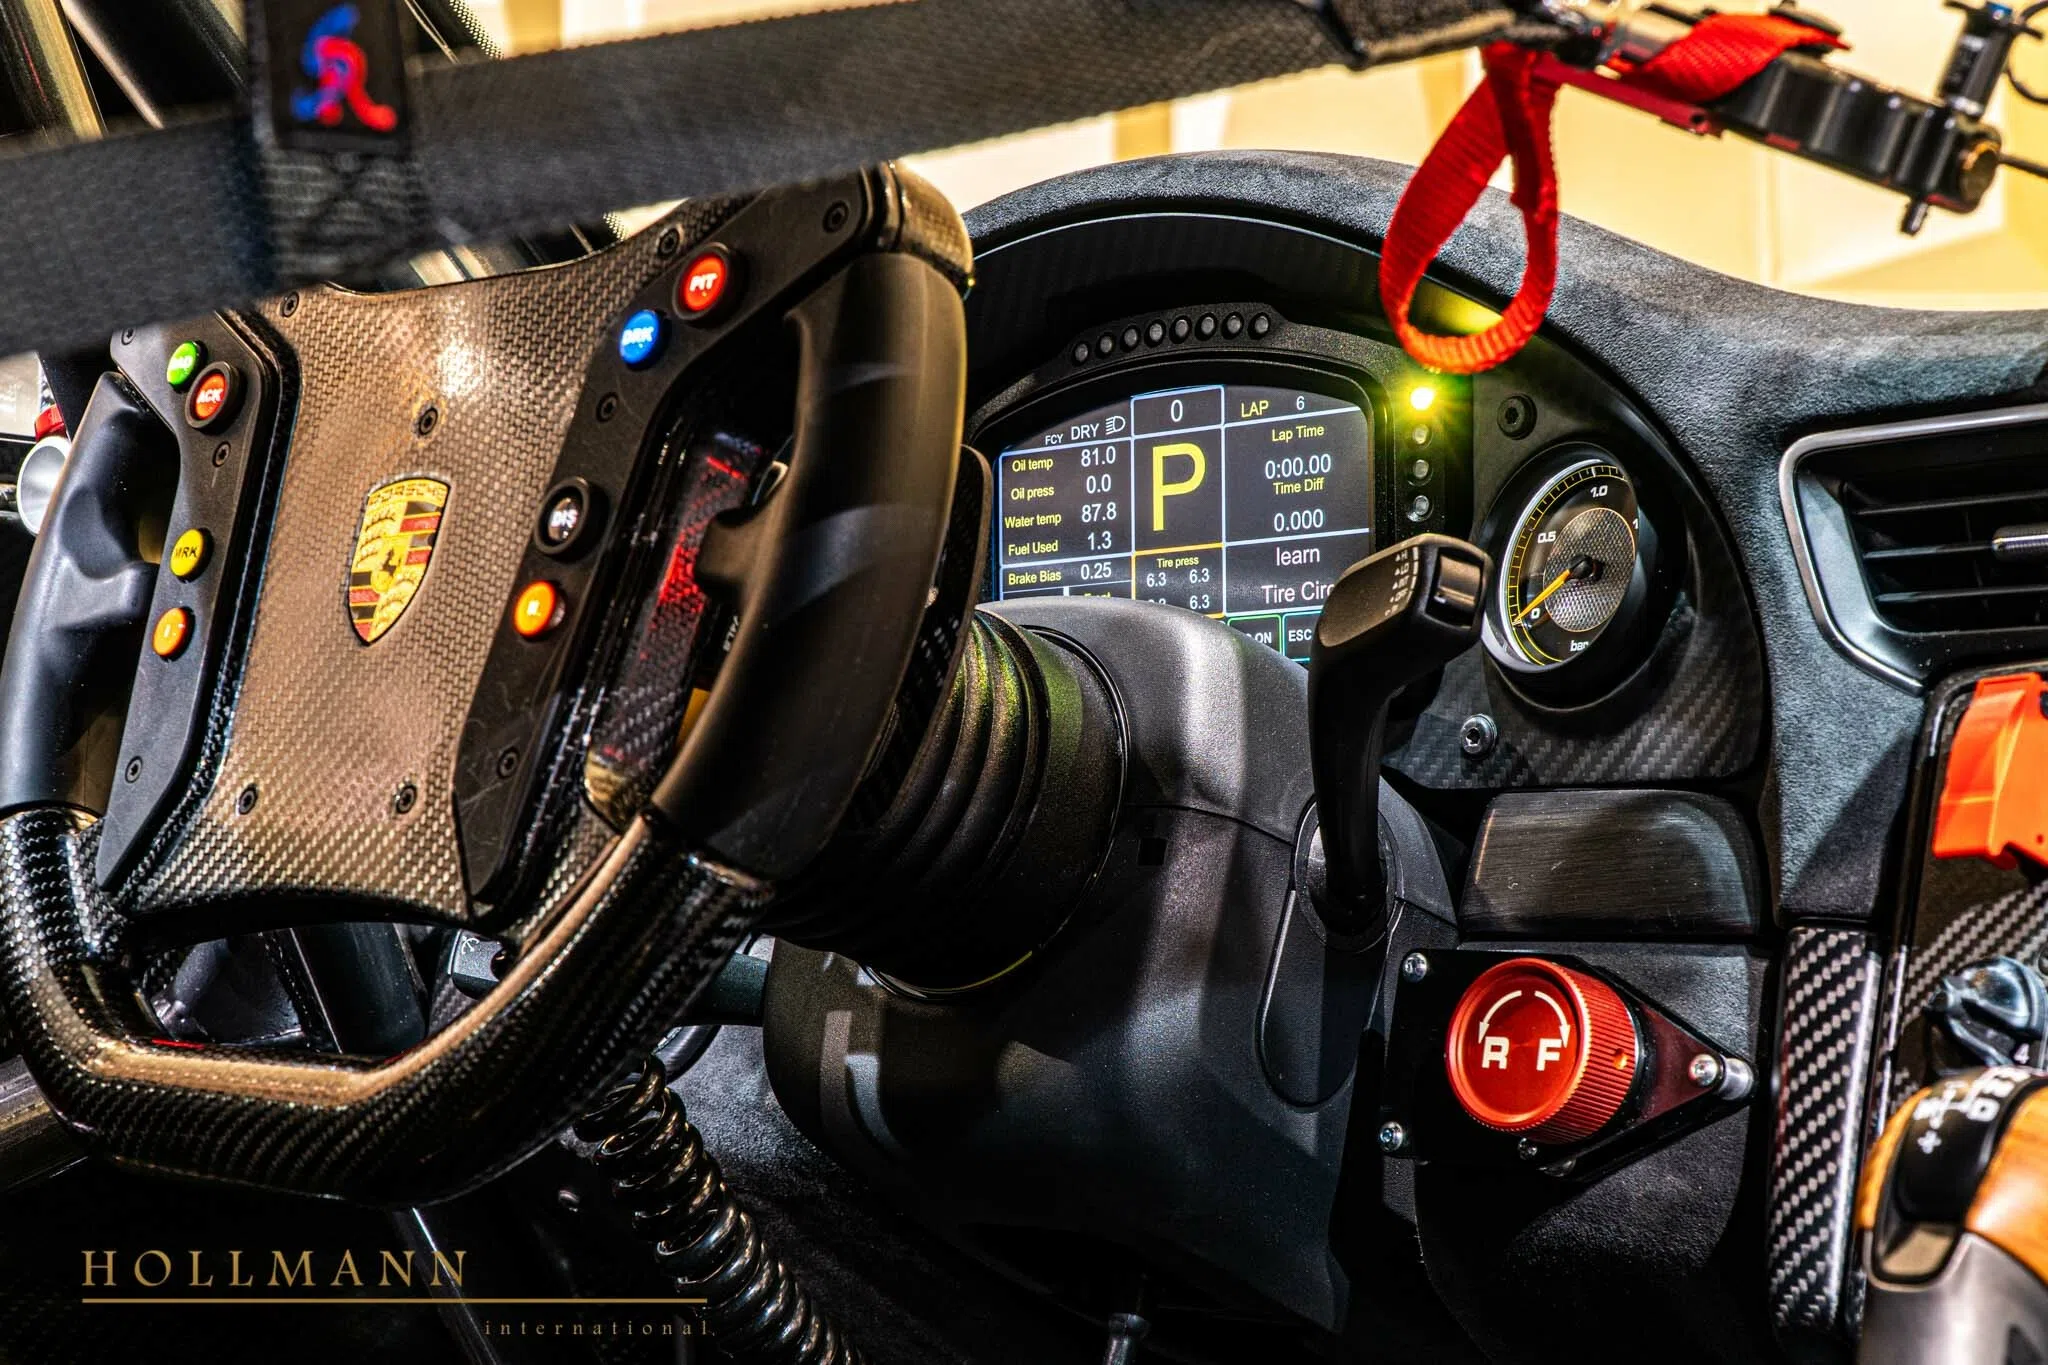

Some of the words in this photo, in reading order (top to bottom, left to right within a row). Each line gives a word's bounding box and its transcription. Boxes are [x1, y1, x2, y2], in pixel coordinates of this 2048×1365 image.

[689, 272, 718, 292] PIT
[1170, 399, 1183, 422] 0
[1241, 400, 1269, 418] LAP
[1296, 396, 1305, 411] 6
[1045, 433, 1064, 446] FCY
[1071, 424, 1100, 441] DRY
[1271, 428, 1293, 443] Lap
[1295, 425, 1325, 438] Time
[1012, 459, 1026, 472] Oil
[1027, 458, 1054, 471] temp
[1081, 446, 1116, 467] 81.0
[1265, 453, 1331, 479] 0:00.00
[1011, 488, 1025, 500] Oil
[1027, 486, 1055, 500] press
[1086, 474, 1112, 494] 0.0
[1152, 442, 1206, 532] P
[1272, 482, 1302, 495] Time
[1304, 477, 1325, 492] Diff
[1590, 485, 1608, 498] 1.0
[1004, 515, 1033, 529] Water
[1036, 512, 1062, 528] temp
[1081, 502, 1117, 523] 87.8
[1273, 508, 1324, 532] 0.000
[1008, 543, 1030, 556] Fuel
[1032, 540, 1059, 555] Used
[1087, 530, 1112, 551] 1.3
[1537, 531, 1556, 544] 0.5
[1157, 557, 1174, 568] Tire
[1175, 556, 1200, 569] press
[1276, 546, 1321, 566] learn
[1008, 571, 1037, 585] Brake
[1039, 569, 1062, 583] Bias
[1080, 561, 1112, 580] 0.25
[1147, 571, 1167, 587] 6.3
[1189, 567, 1210, 584] 6.3
[1189, 594, 1210, 610] 6.3
[1261, 584, 1296, 604] Tire
[1288, 628, 1312, 642] ESC
[1482, 1036, 1511, 1070] R
[1536, 1037, 1565, 1072] F
